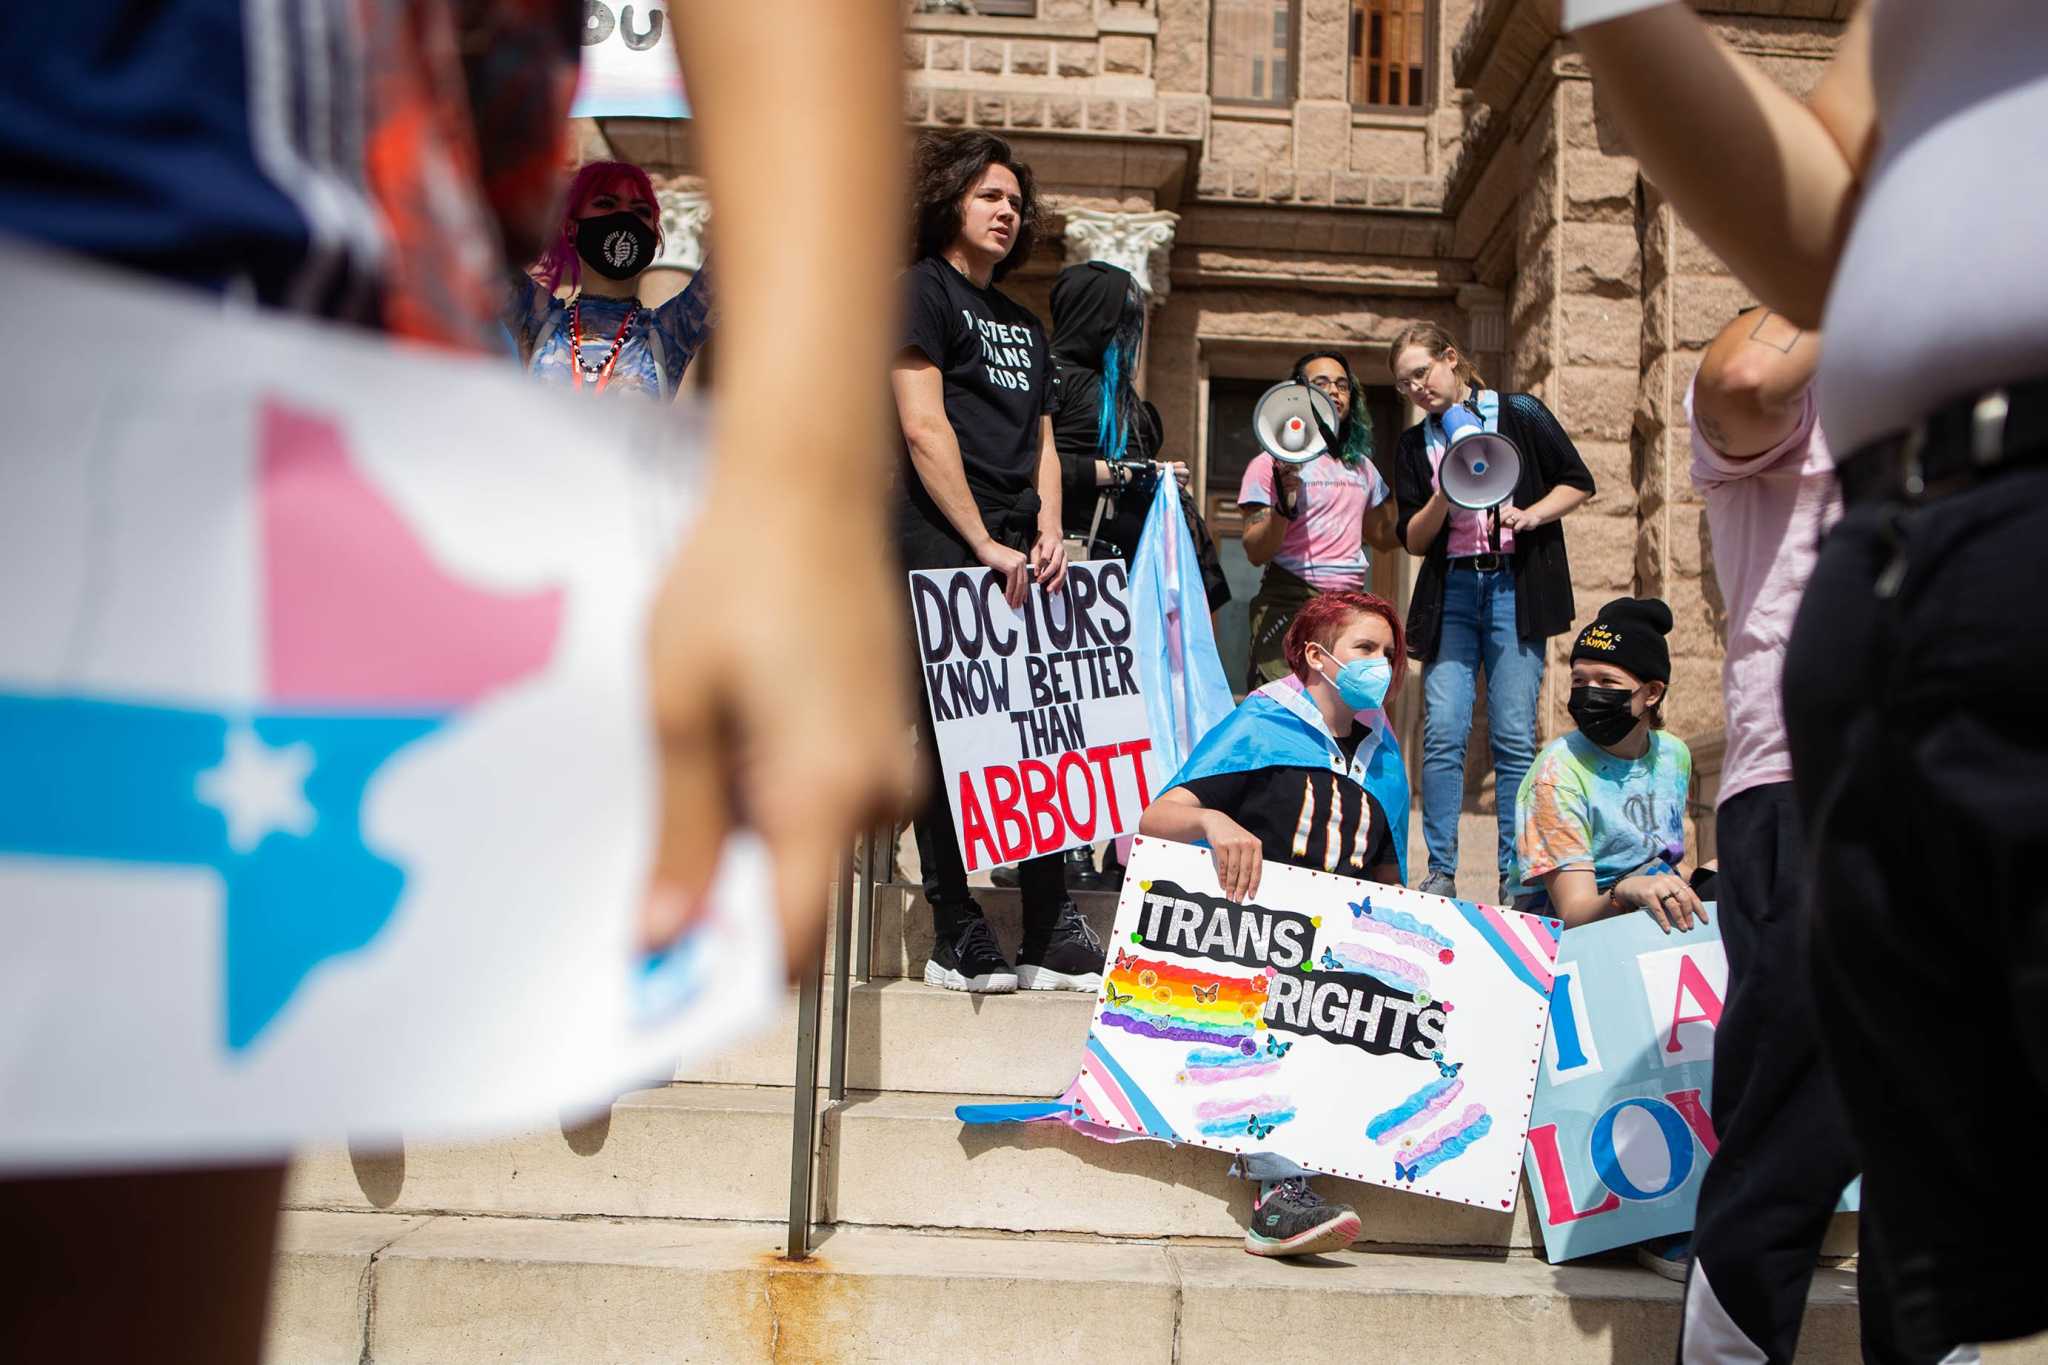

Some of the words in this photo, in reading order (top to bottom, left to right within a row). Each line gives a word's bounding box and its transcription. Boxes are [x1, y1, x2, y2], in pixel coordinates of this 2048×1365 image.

[962, 310, 1033, 347] POTECT
[985, 364, 1030, 391] KIDS
[911, 562, 1132, 664] DOCTORS
[926, 658, 1010, 721] KNOW
[1025, 646, 1140, 708] BETTER
[1010, 703, 1087, 758] THAN
[960, 738, 1152, 872] ABBOTT
[1144, 893, 1305, 969] TRANS
[1264, 973, 1448, 1060] RIGHTS
[1549, 973, 1588, 1072] I
